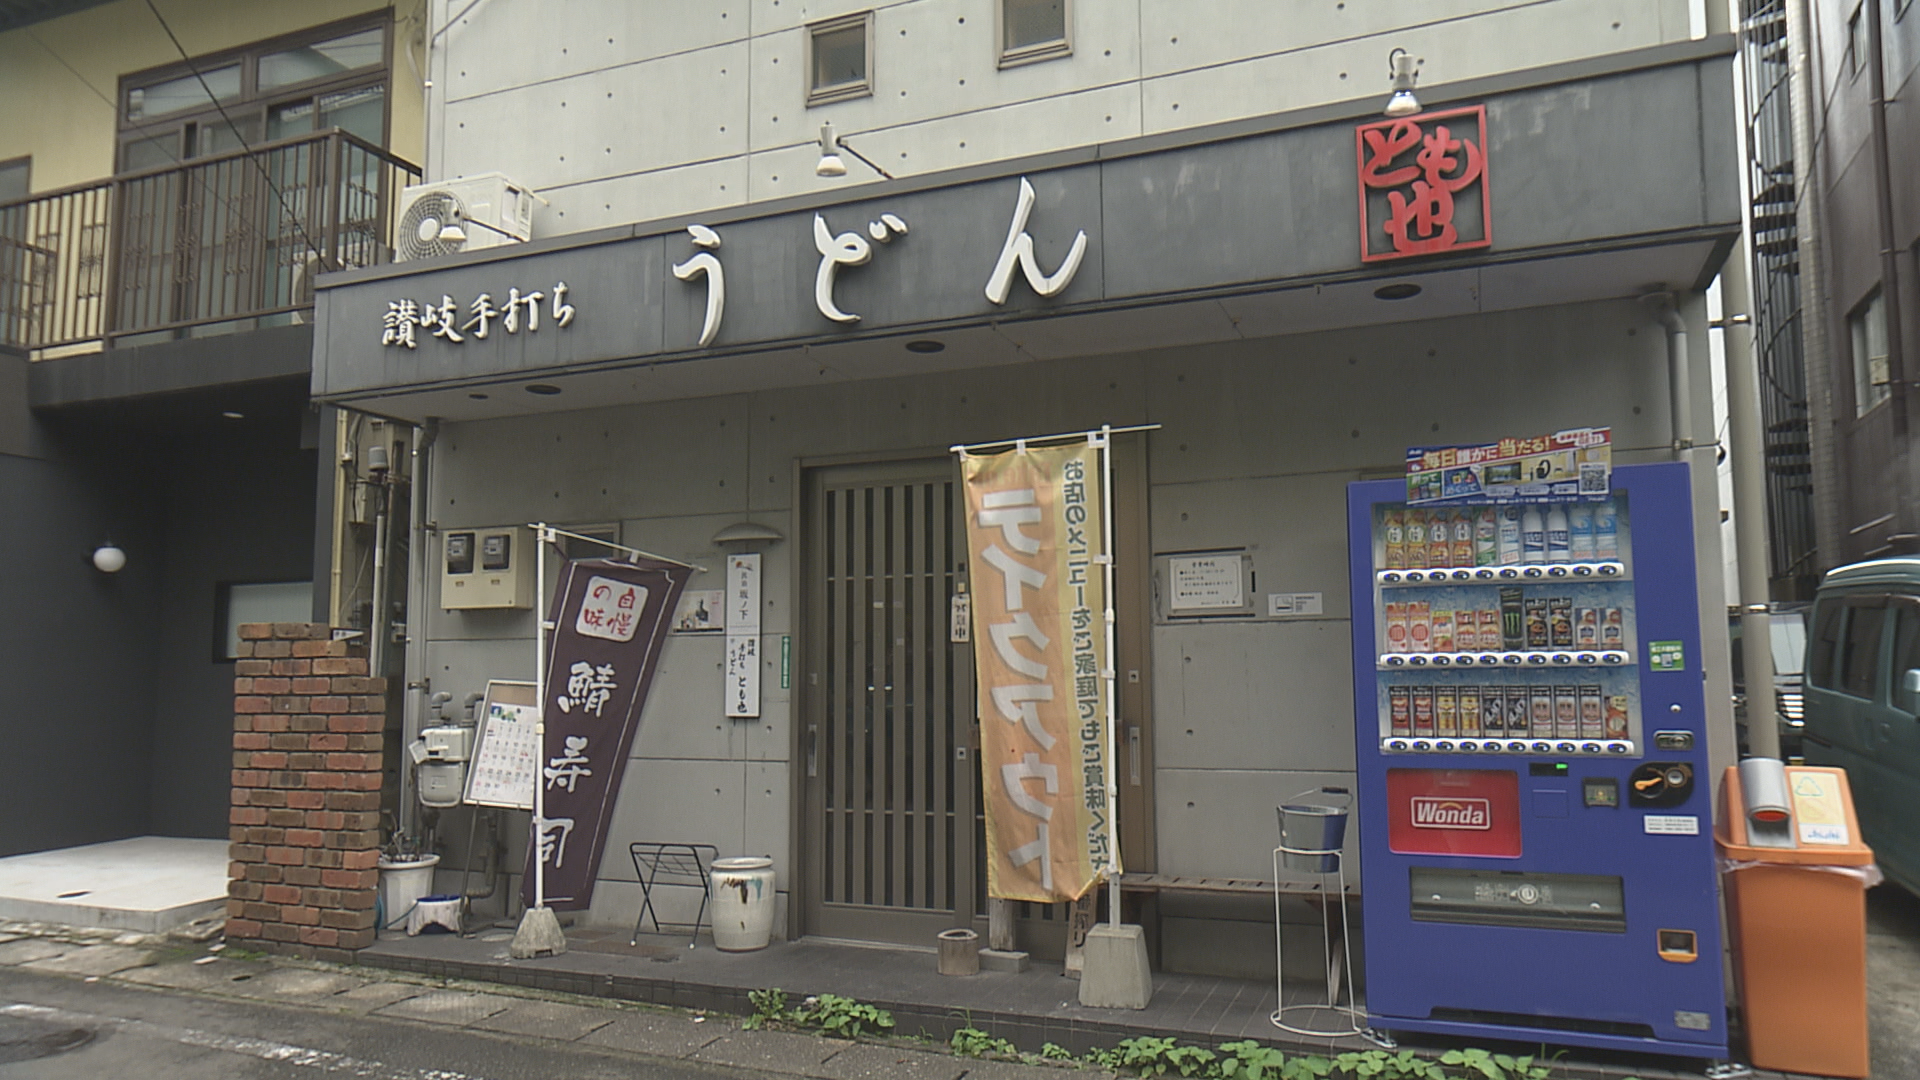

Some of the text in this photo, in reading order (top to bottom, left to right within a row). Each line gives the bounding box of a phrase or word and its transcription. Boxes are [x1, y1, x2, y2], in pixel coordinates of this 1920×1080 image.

[382, 280, 575, 348] 讃岐手打ち
[672, 175, 1088, 348] うどん
[542, 660, 619, 868] 鯖寿司
[1416, 801, 1485, 826] Wonda
